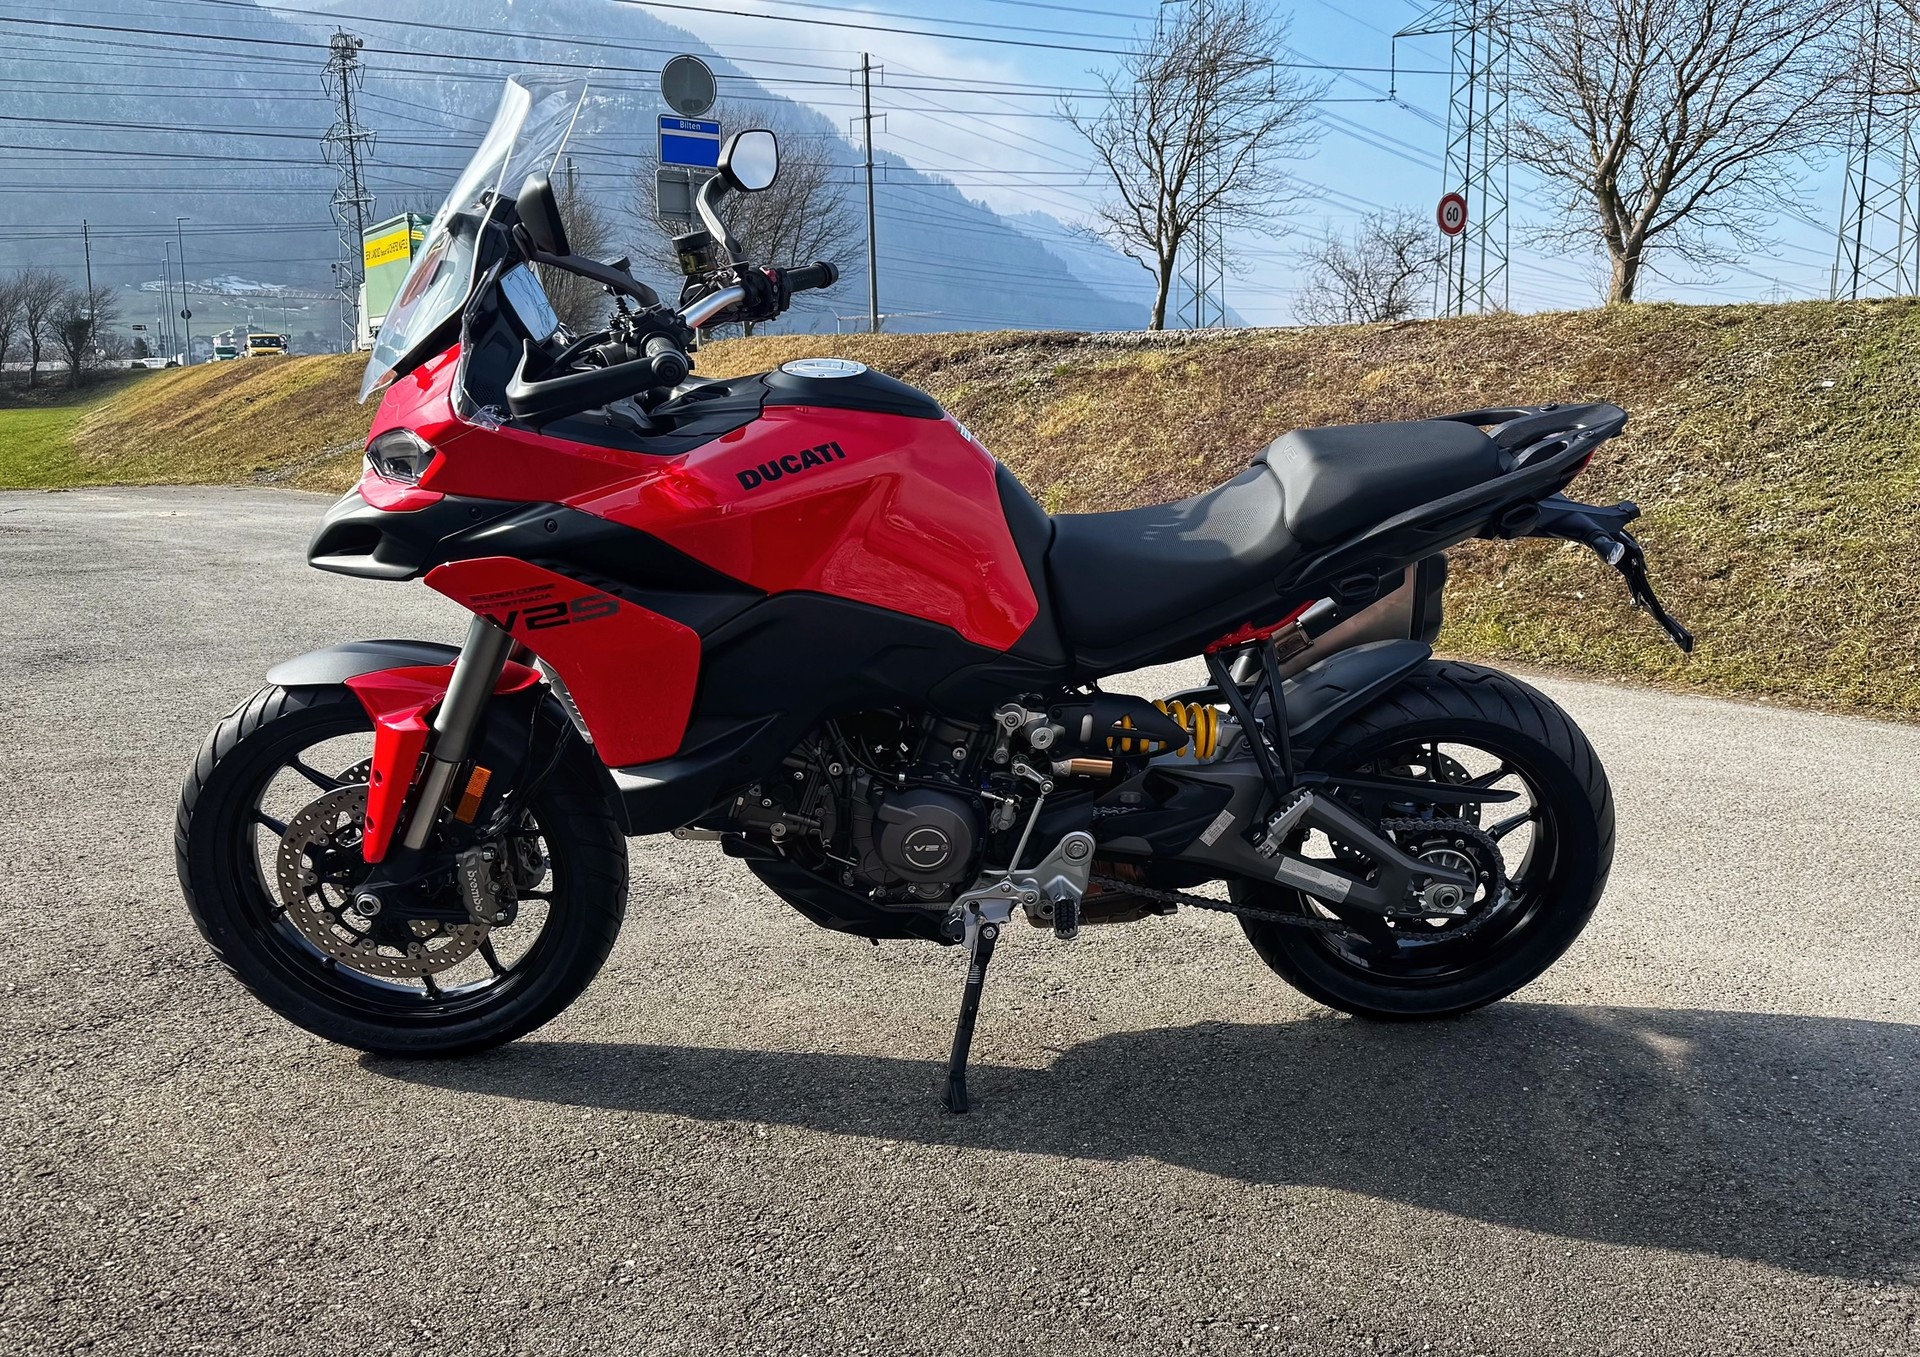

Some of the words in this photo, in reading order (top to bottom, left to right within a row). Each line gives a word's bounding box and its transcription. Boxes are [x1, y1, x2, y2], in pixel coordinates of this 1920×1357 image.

[679, 120, 701, 130] Bilten
[1446, 206, 1459, 222] 60
[736, 441, 846, 491] DUCATI
[913, 844, 940, 852] V2
[466, 869, 484, 913] brembo
